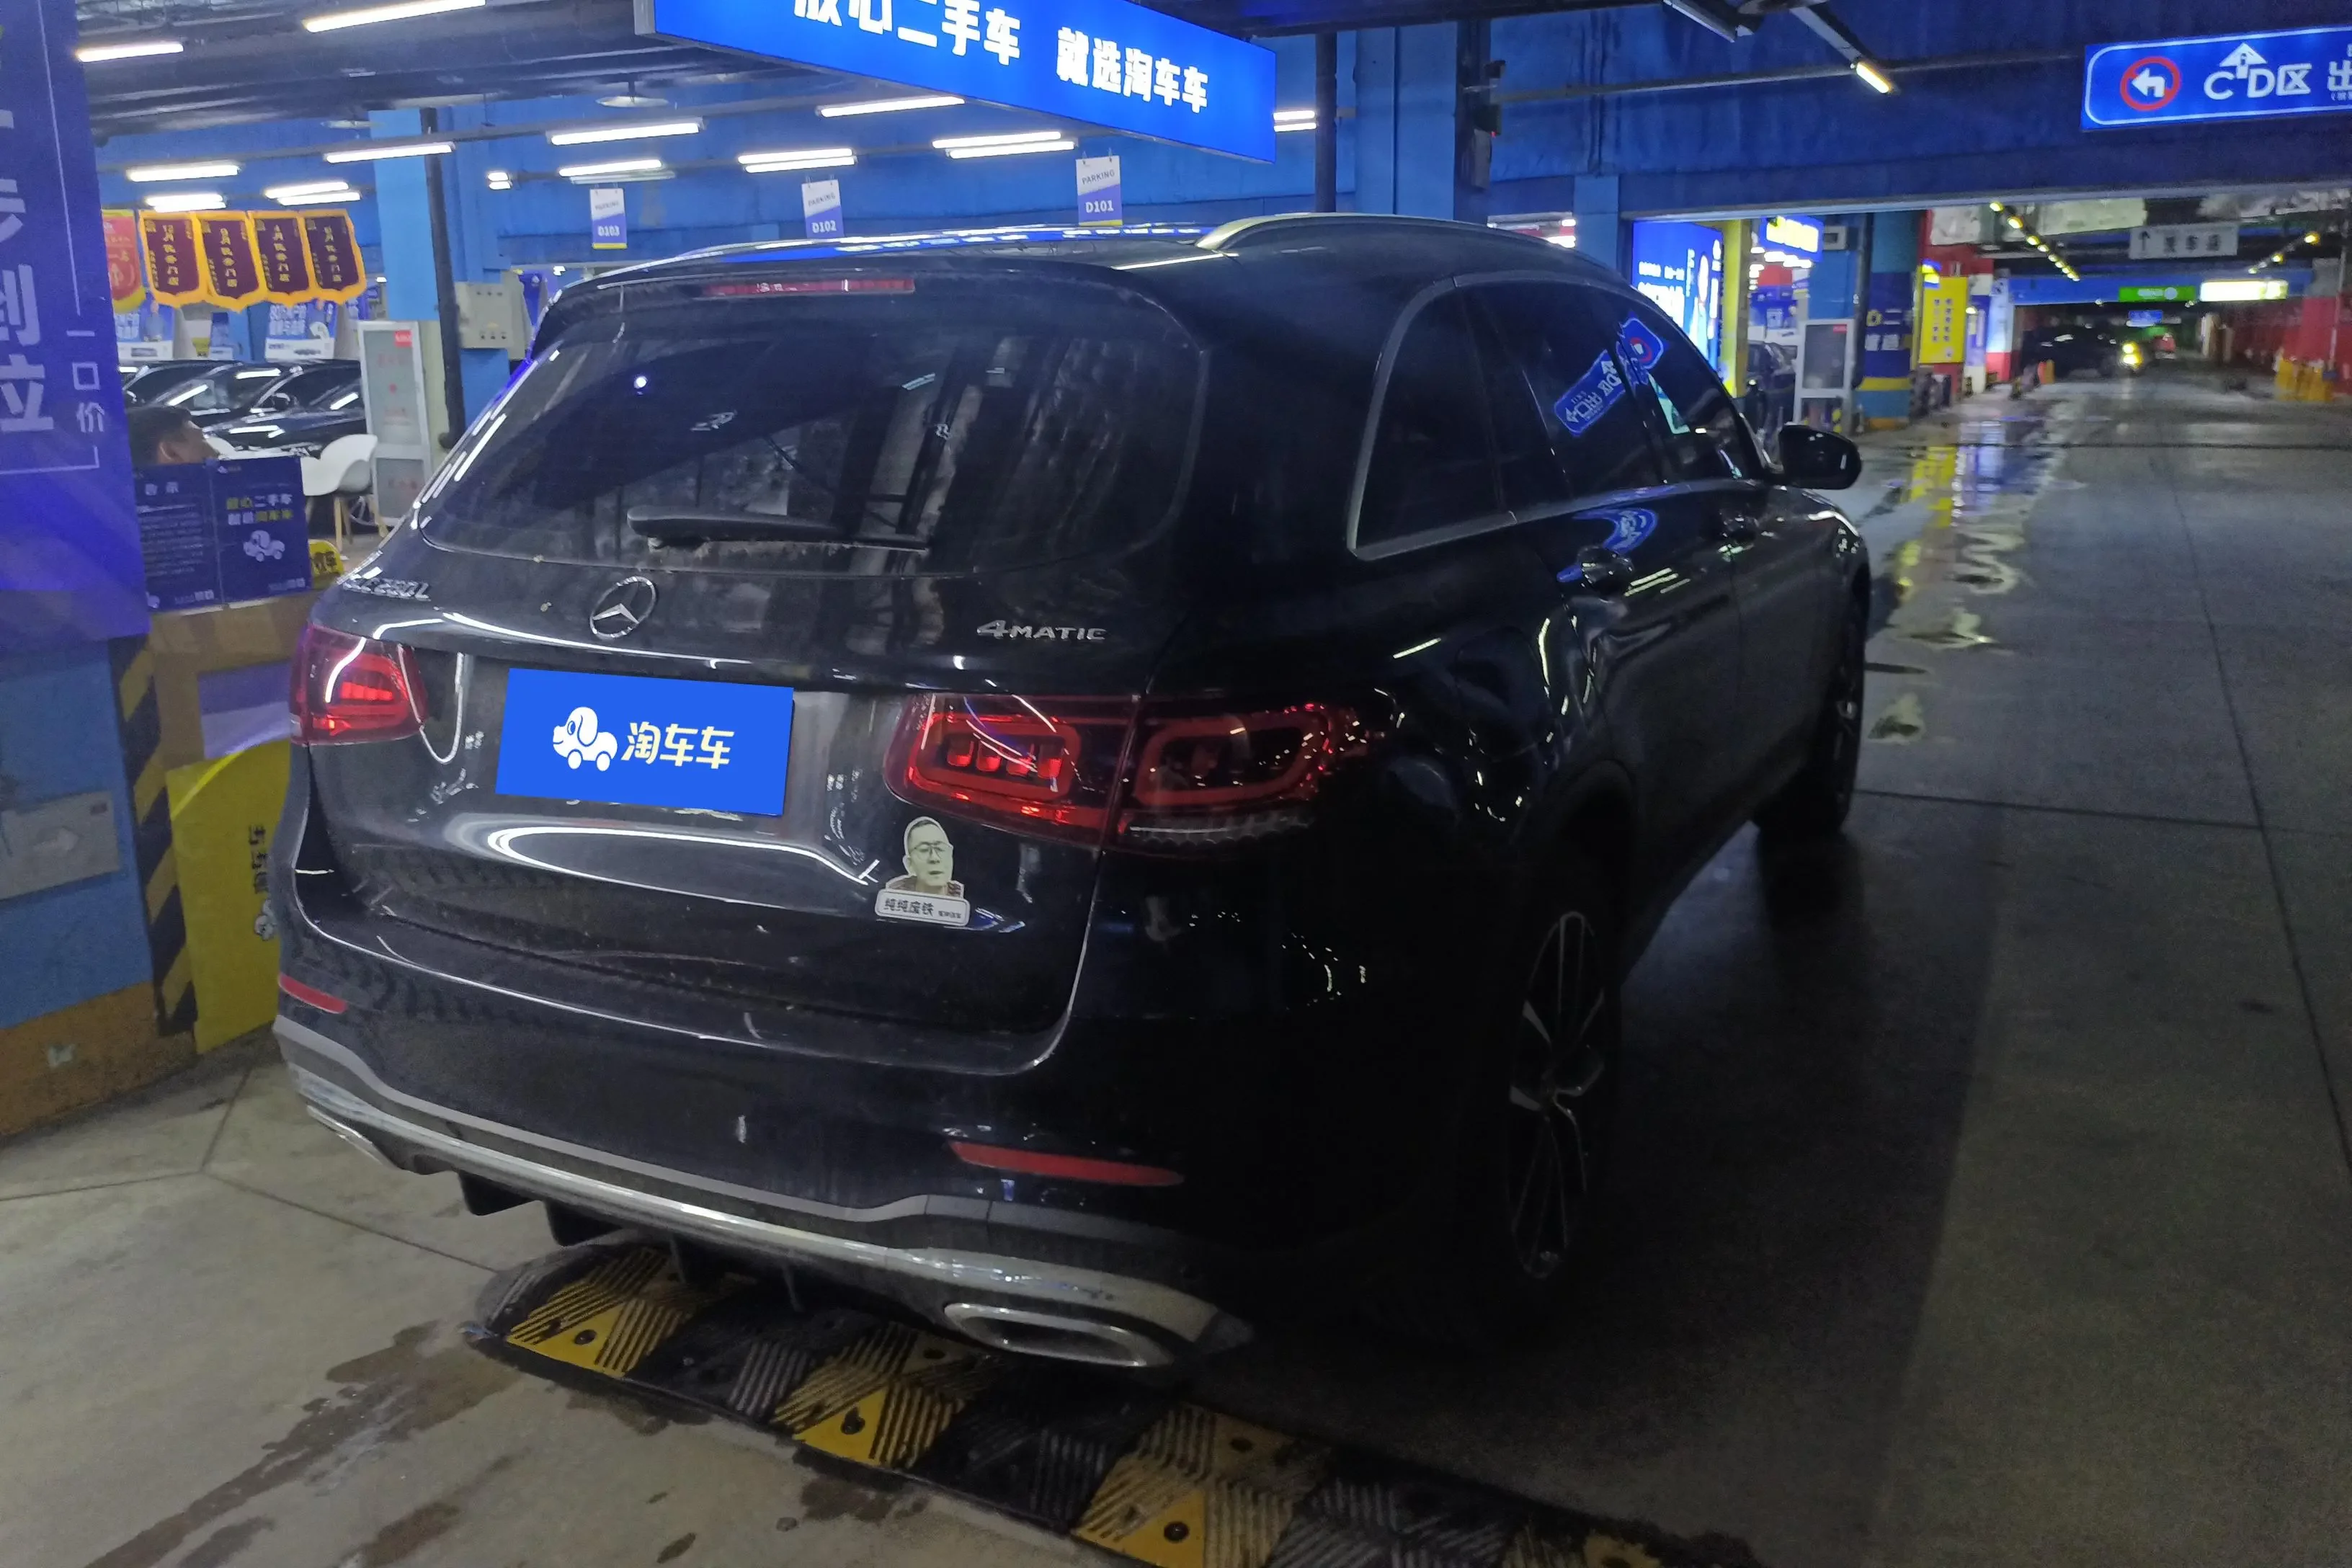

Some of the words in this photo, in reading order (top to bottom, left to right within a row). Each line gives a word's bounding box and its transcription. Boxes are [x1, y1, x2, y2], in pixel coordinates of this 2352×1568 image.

[1056, 27, 1208, 113] 就选淘车车
[1082, 169, 1115, 184] PARKING
[1085, 200, 1114, 213] D101
[811, 220, 837, 233] D102
[66, 329, 106, 434] 一口价
[976, 620, 1108, 640] 4MATIC
